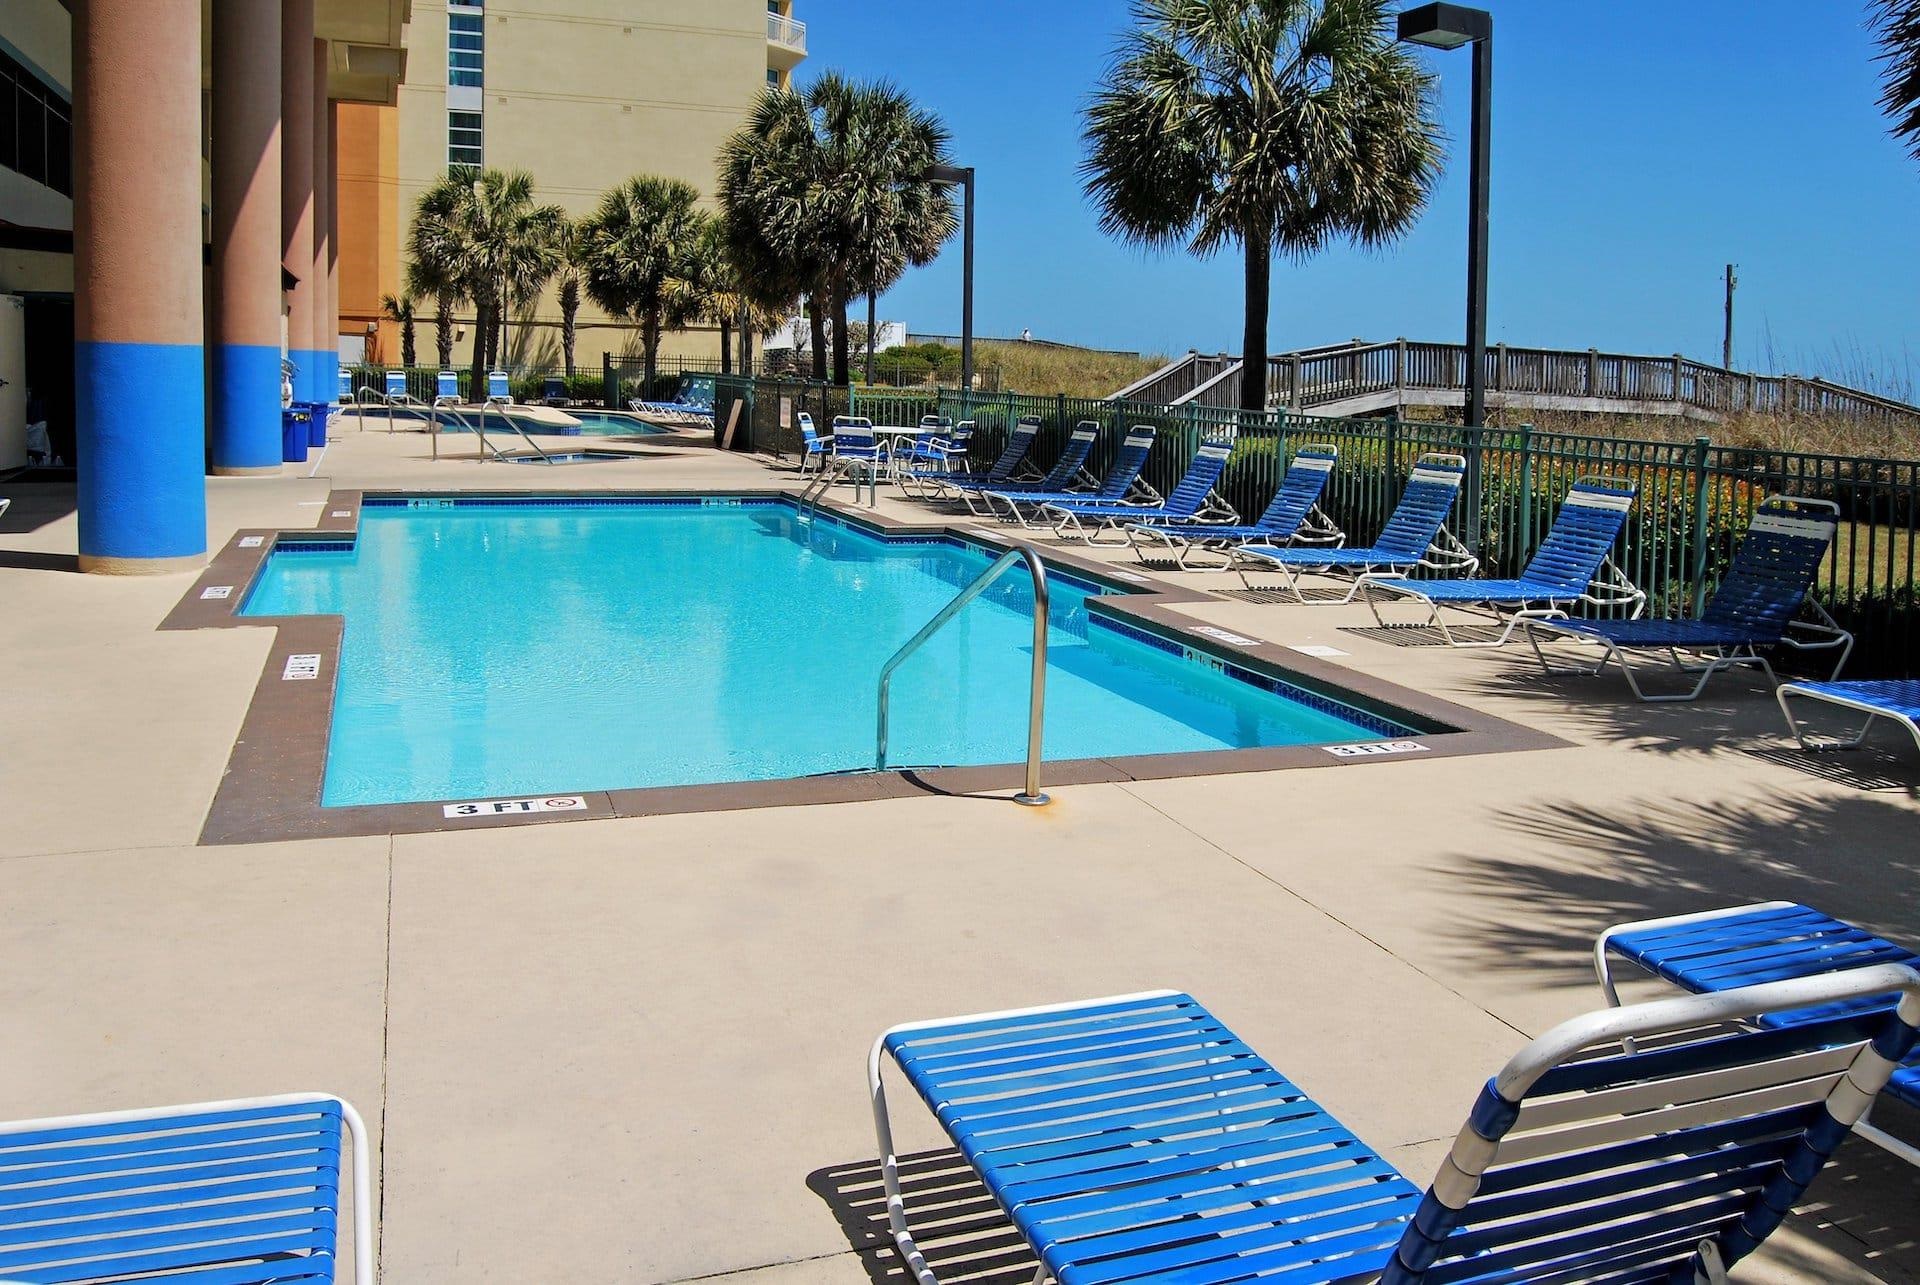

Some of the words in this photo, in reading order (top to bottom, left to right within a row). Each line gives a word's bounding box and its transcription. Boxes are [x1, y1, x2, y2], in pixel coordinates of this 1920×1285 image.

[1210, 659, 1223, 672] FT
[1333, 747, 1356, 755] 3
[456, 804, 478, 815] 3
[493, 800, 534, 813] FT
